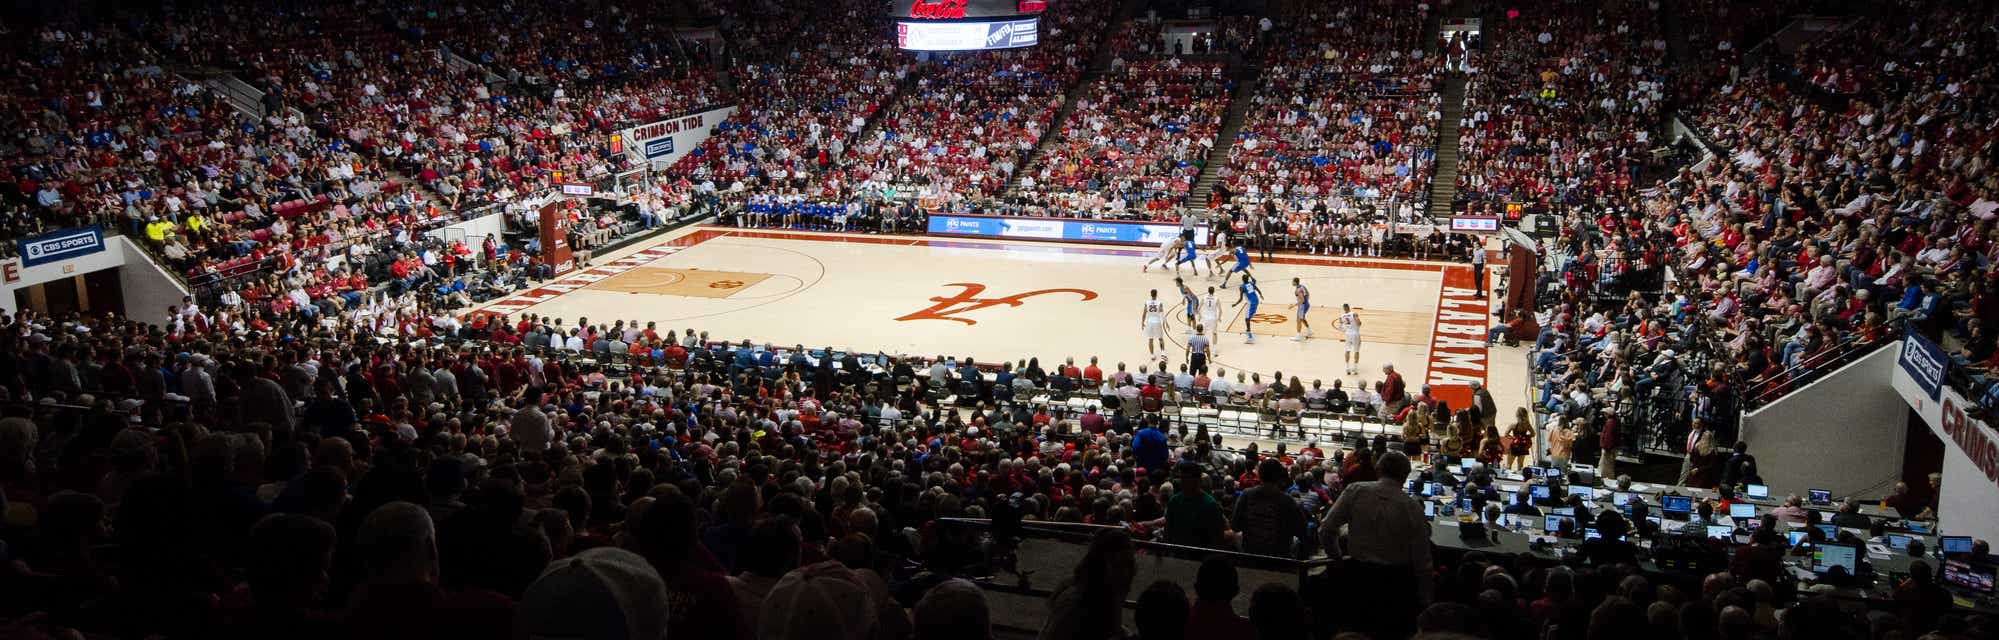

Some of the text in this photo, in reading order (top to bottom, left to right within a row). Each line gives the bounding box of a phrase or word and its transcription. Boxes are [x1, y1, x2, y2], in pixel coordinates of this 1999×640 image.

[633, 116, 704, 141] CRIMSON TIDE
[43, 235, 94, 252] CBS SPORTS
[2, 262, 21, 282] E
[1148, 304, 1158, 313] 25
[1428, 286, 1488, 386] ALABAMA
[1913, 347, 1940, 381] CBS SPORTS
[1941, 397, 1999, 487] CRIMS
